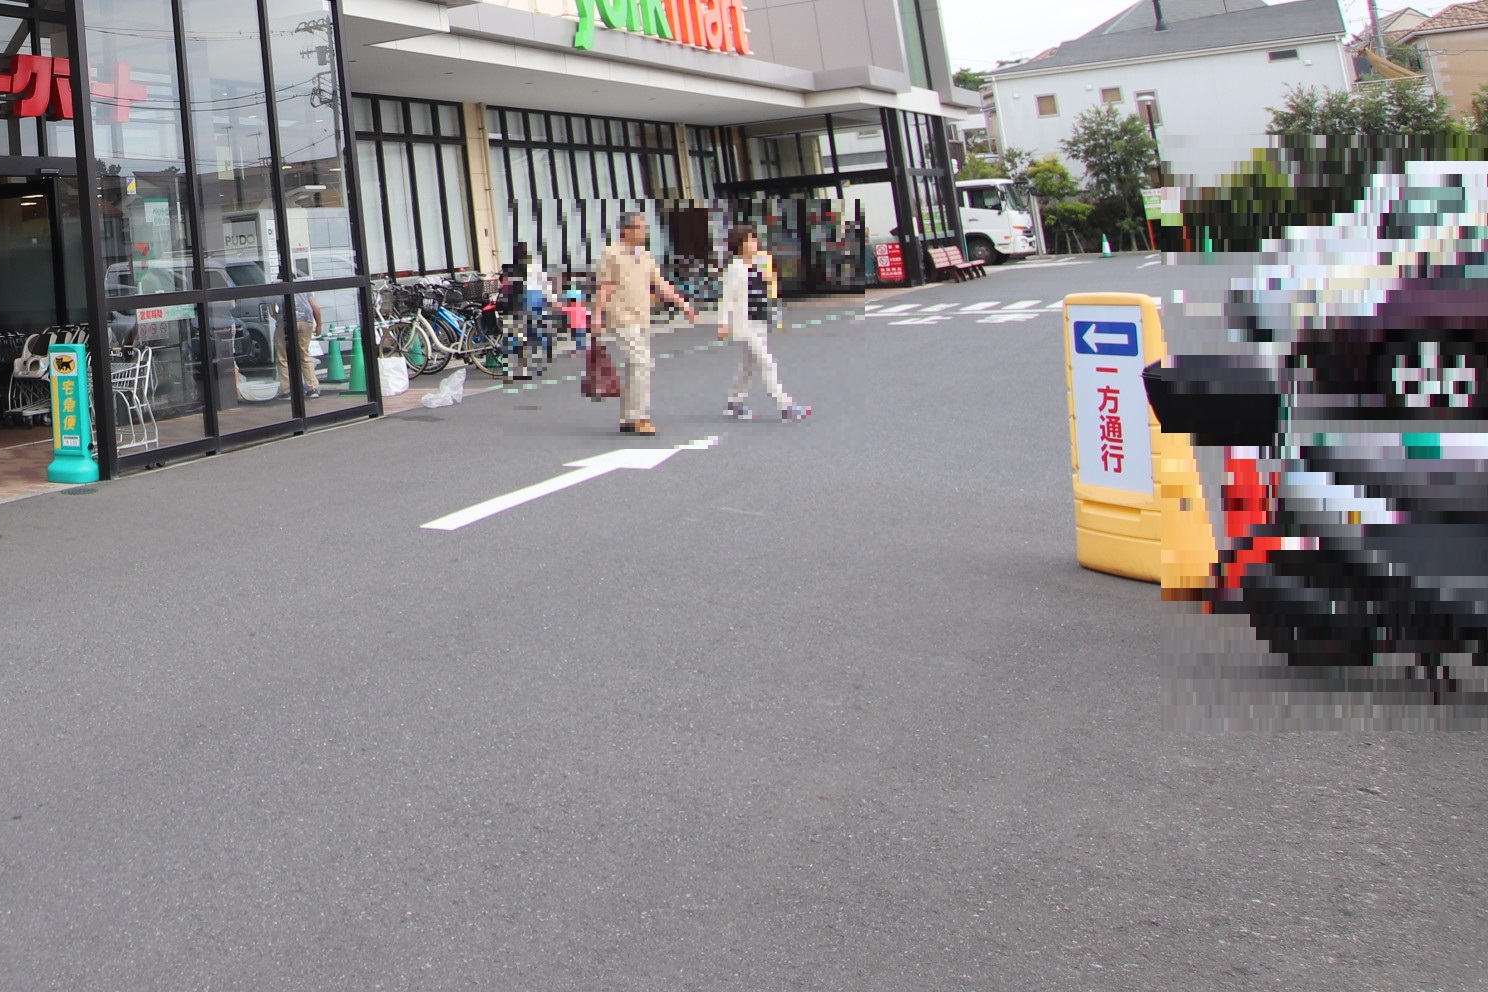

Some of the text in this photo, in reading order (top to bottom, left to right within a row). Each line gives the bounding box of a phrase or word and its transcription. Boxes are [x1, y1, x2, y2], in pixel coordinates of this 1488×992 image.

[62, 379, 77, 431] 宅急便
[1095, 366, 1125, 474] 一方通行
